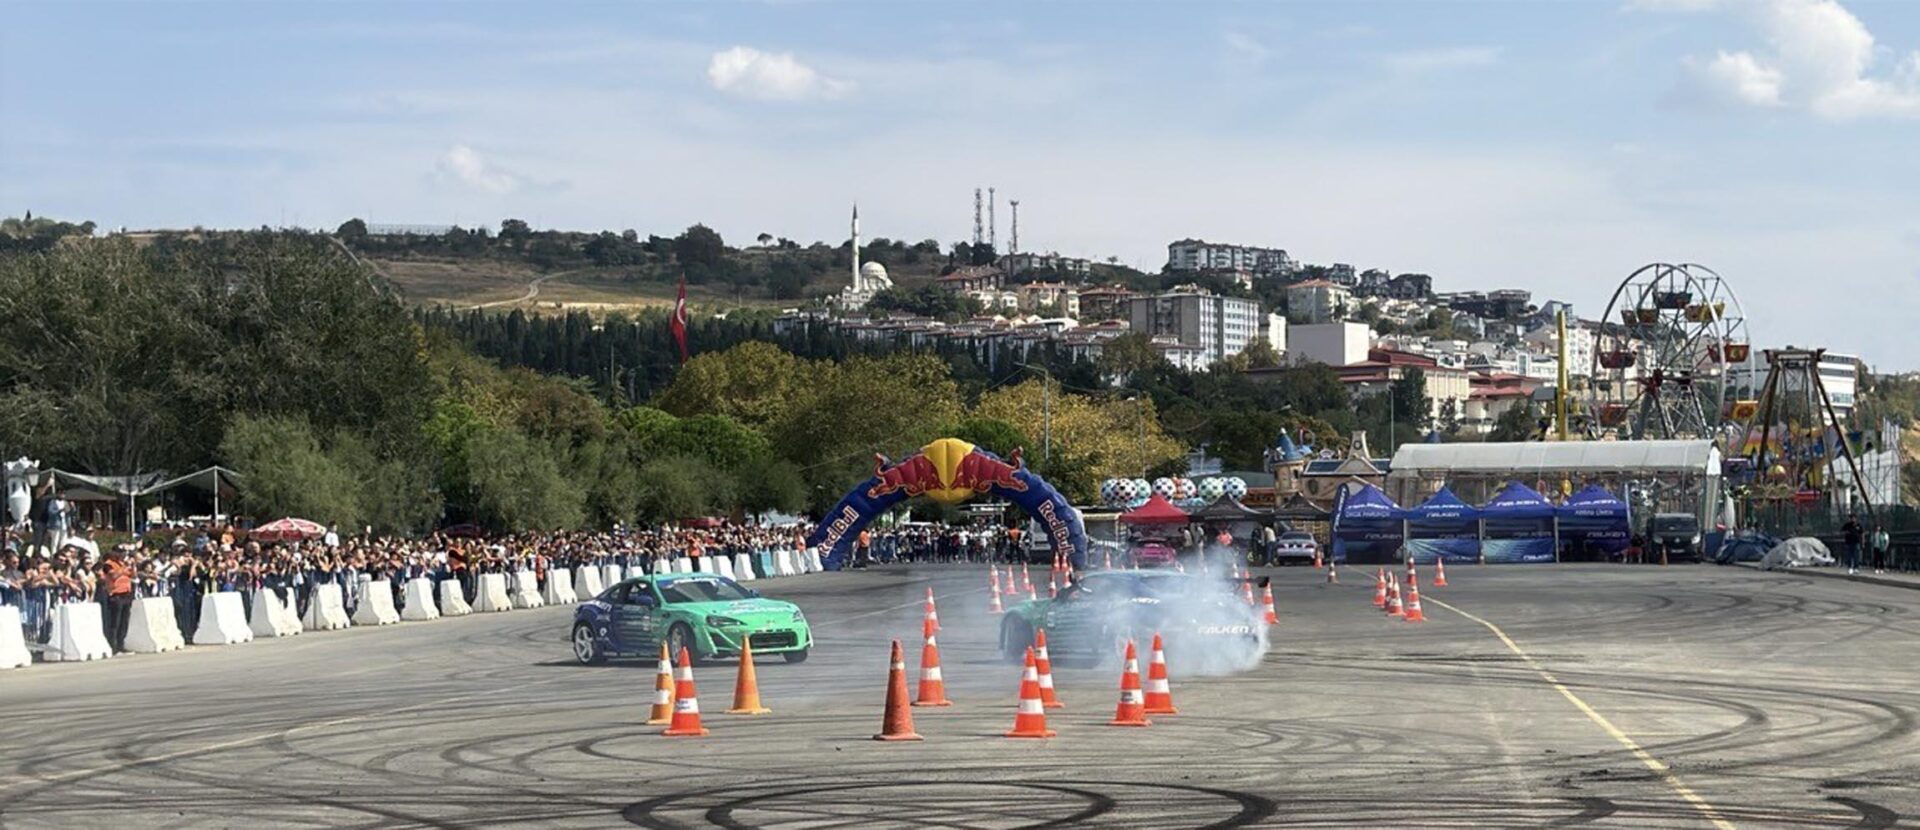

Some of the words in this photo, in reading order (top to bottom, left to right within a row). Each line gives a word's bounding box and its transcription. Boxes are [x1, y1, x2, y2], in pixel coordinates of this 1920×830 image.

[817, 526, 841, 558] Red
[831, 505, 860, 535] Bull
[1037, 499, 1066, 531] Red
